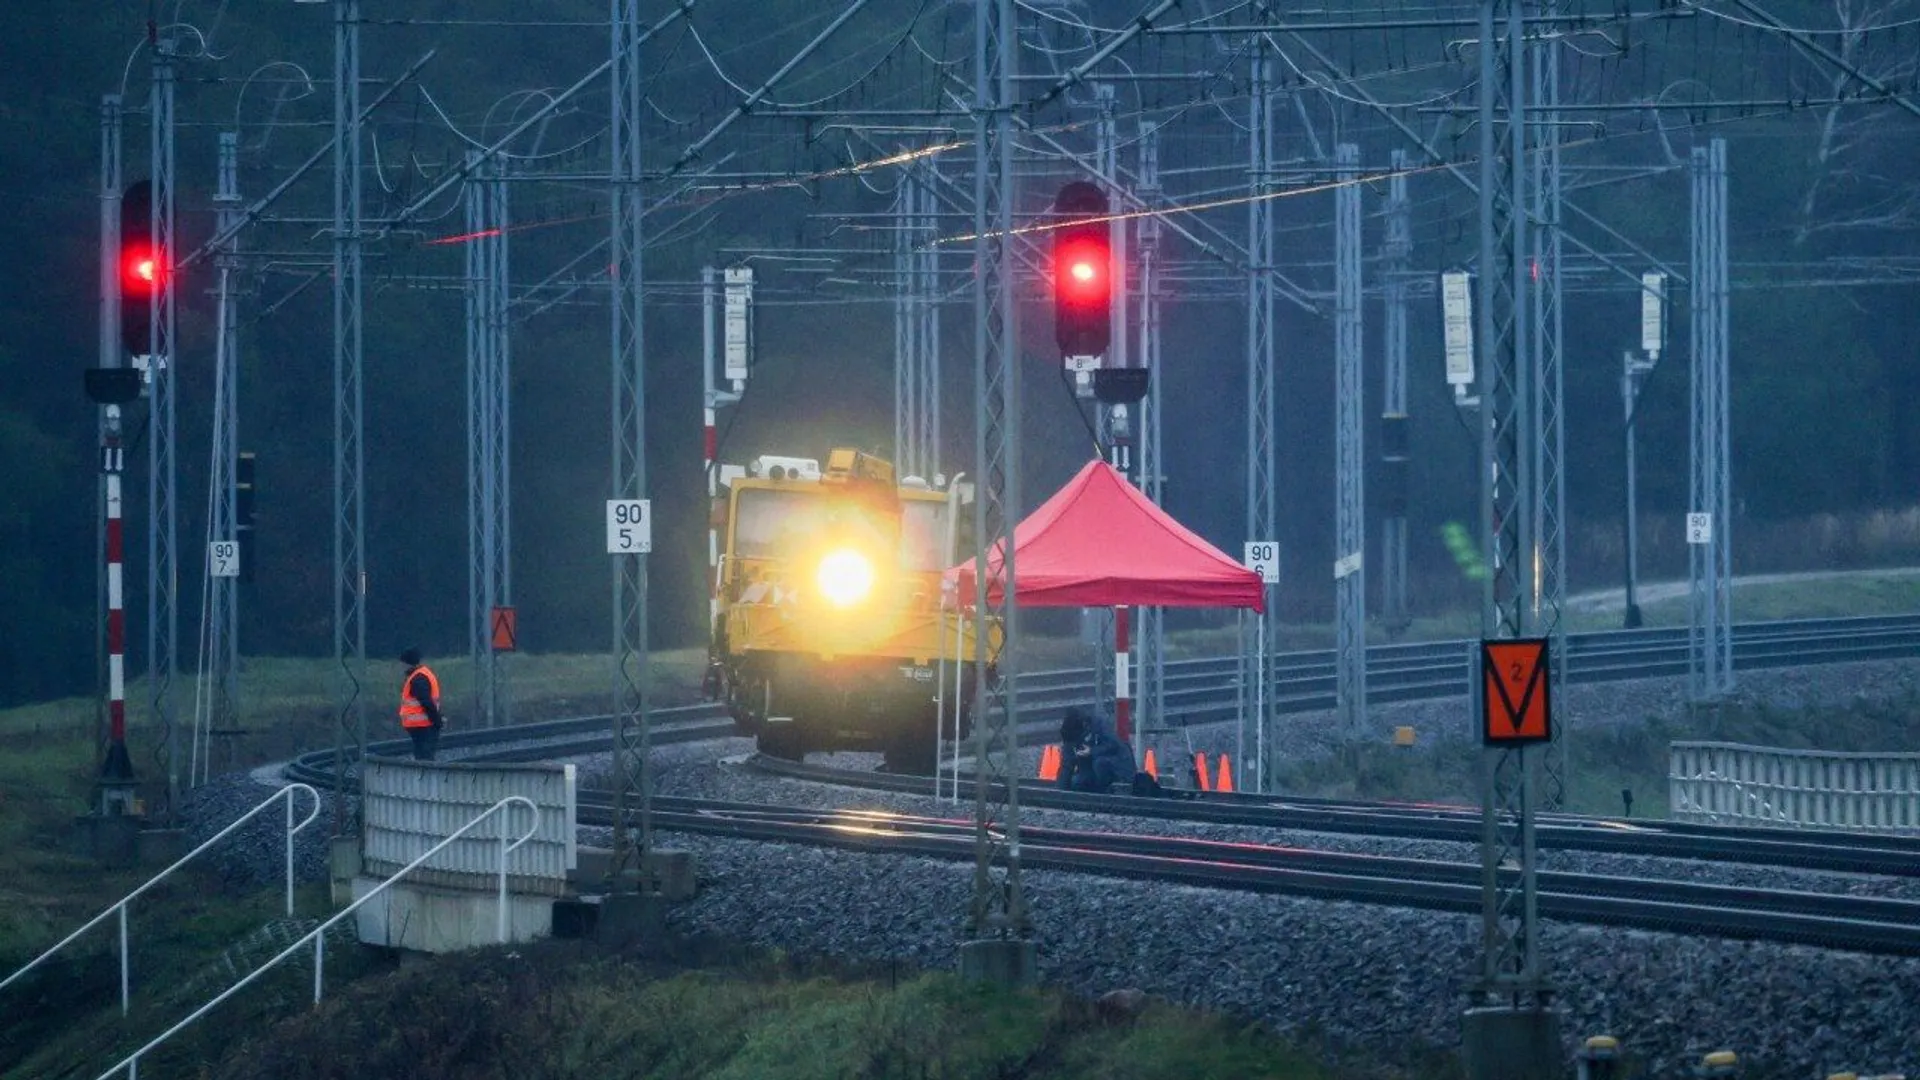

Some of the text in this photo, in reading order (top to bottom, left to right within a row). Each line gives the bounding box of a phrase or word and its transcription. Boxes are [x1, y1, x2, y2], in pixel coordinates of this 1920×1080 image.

[615, 503, 642, 524] 90
[1691, 515, 1707, 528] 90
[619, 528, 632, 549] 5
[215, 543, 234, 559] 90
[1252, 545, 1272, 561] 90
[218, 559, 227, 574] 7
[1510, 661, 1523, 682] 2
